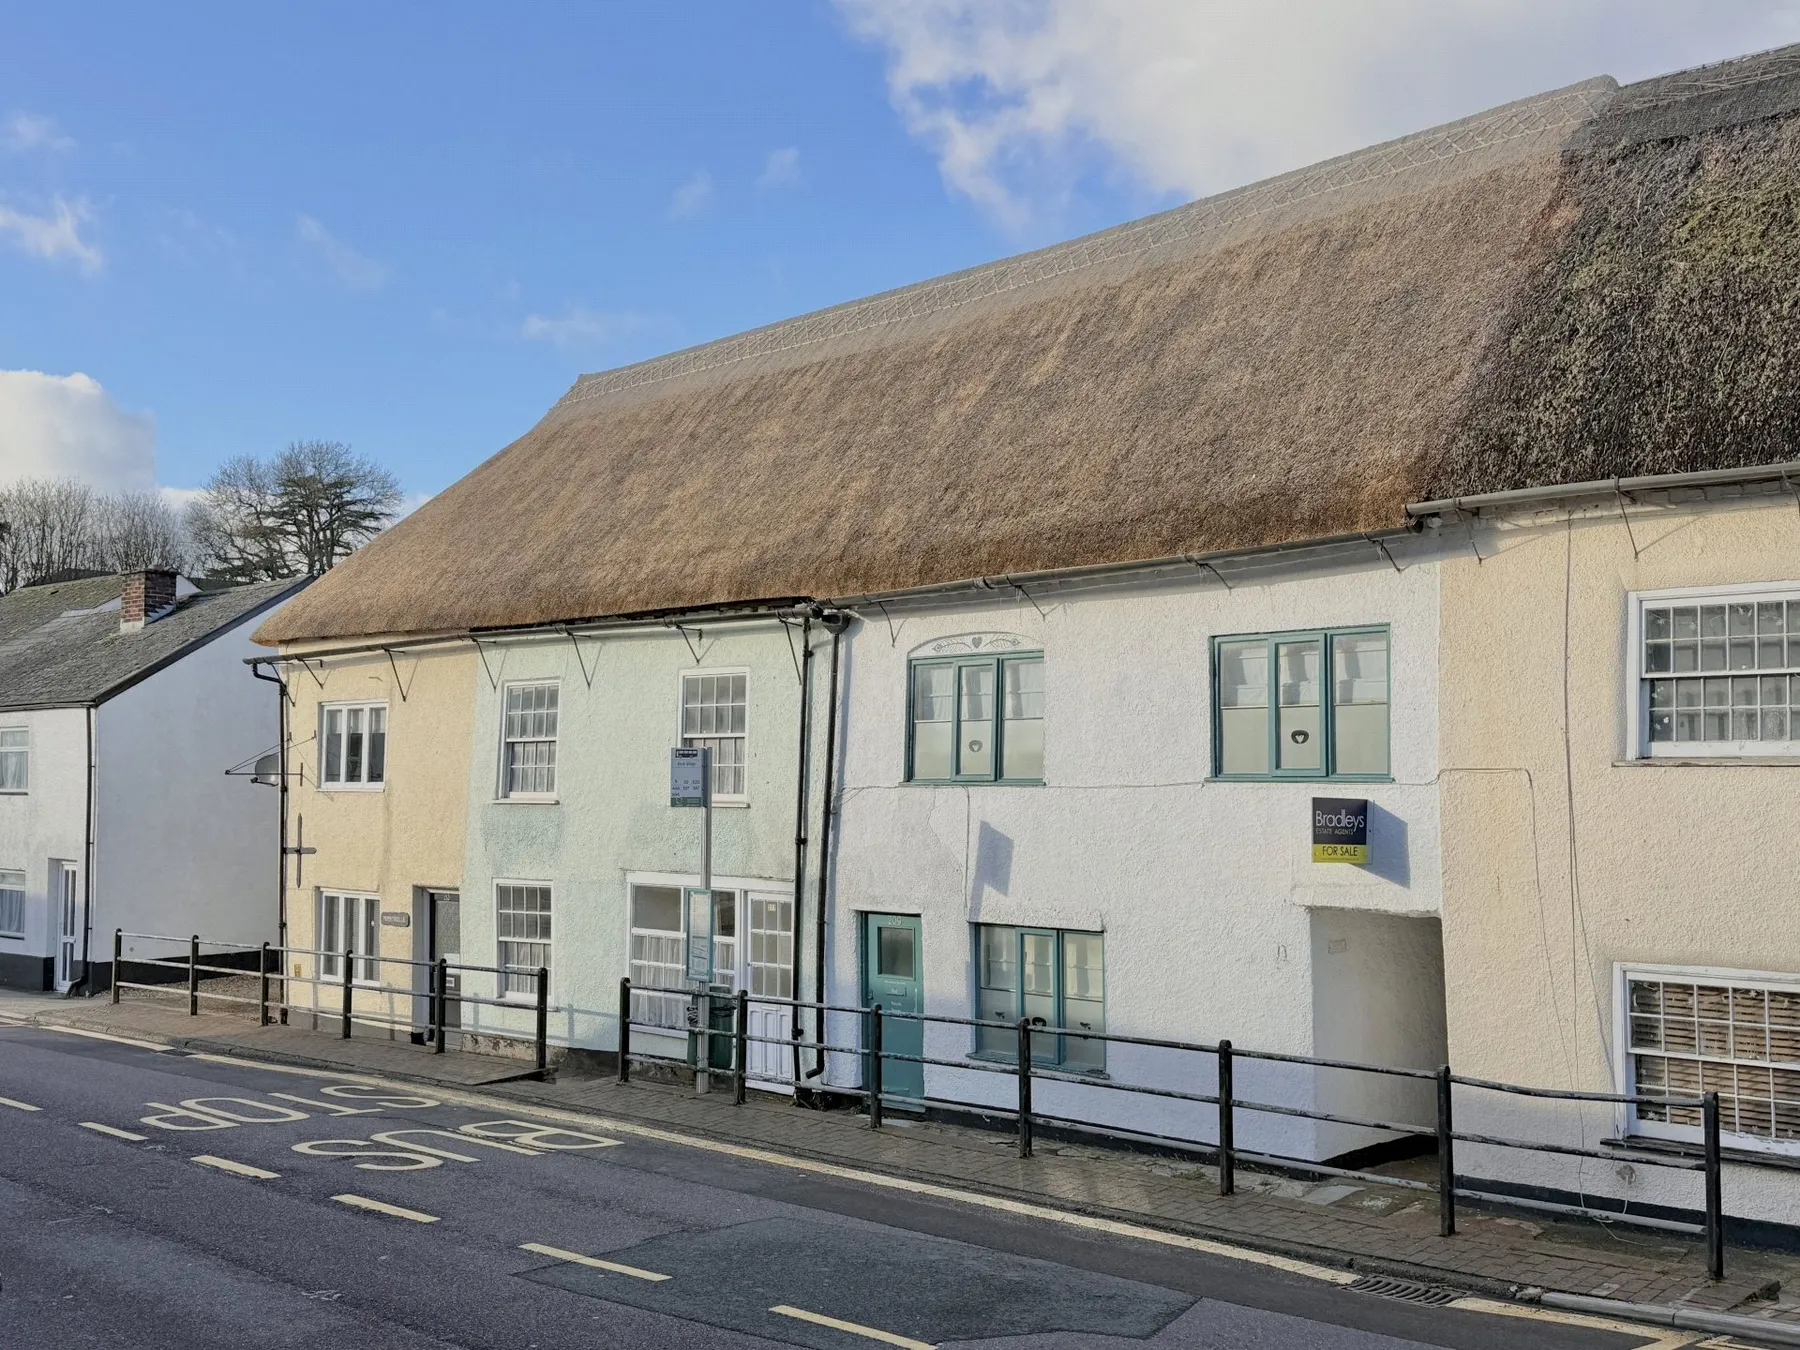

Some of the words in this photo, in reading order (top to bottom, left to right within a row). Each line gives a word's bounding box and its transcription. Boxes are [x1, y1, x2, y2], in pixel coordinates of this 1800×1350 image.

[1315, 809, 1364, 832] Bradleys
[1322, 846, 1338, 856] FOR
[1340, 846, 1358, 856] SALE
[140, 1085, 441, 1131] STOP
[291, 1120, 625, 1171] BUS
